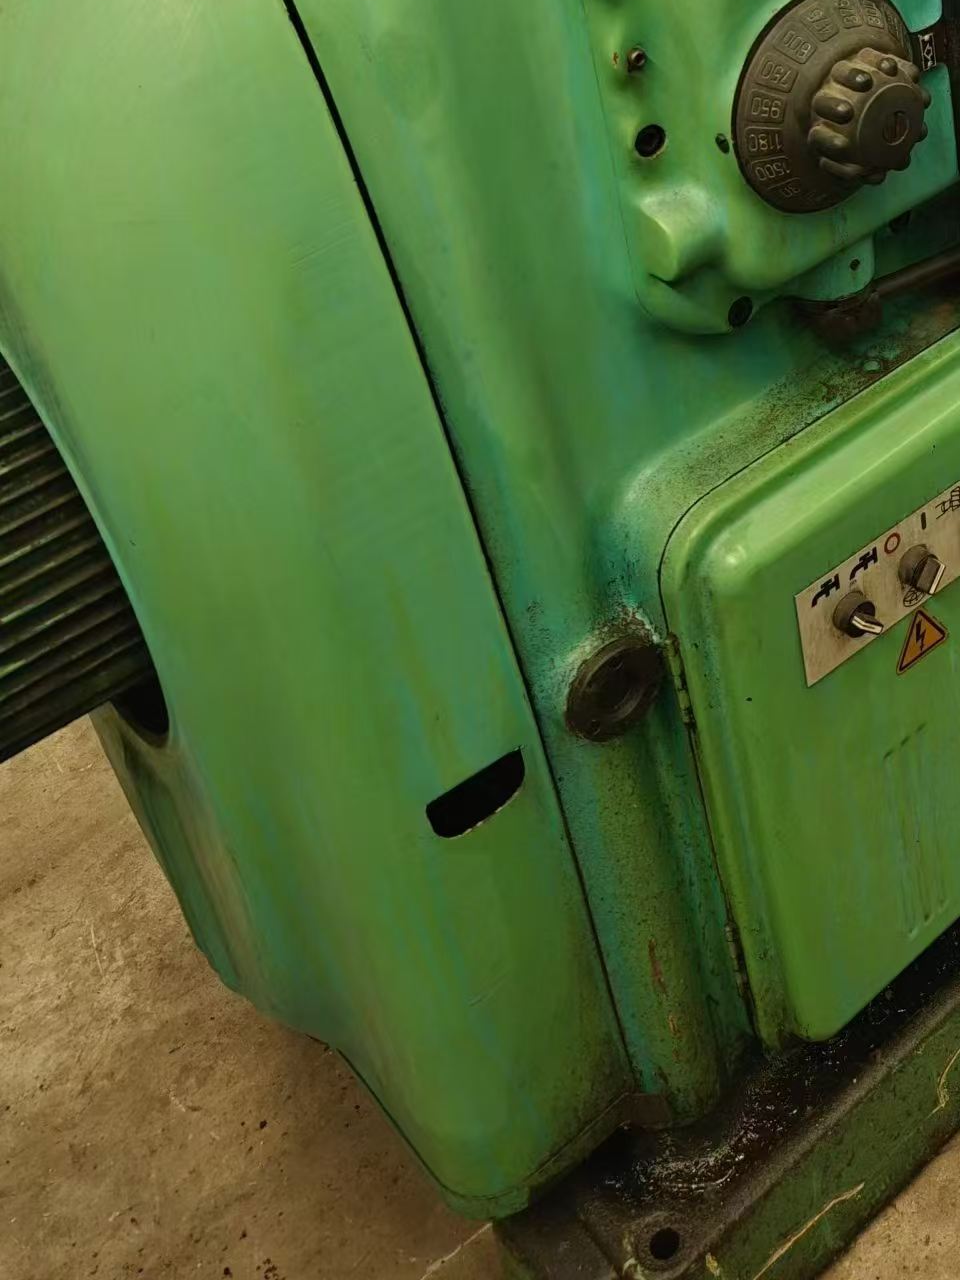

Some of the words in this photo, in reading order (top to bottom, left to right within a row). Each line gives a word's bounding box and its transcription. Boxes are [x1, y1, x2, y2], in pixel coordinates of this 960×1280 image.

[762, 59, 792, 88] 750
[751, 97, 781, 118] 950
[750, 133, 782, 150] 1180
[755, 162, 791, 181] 1500
